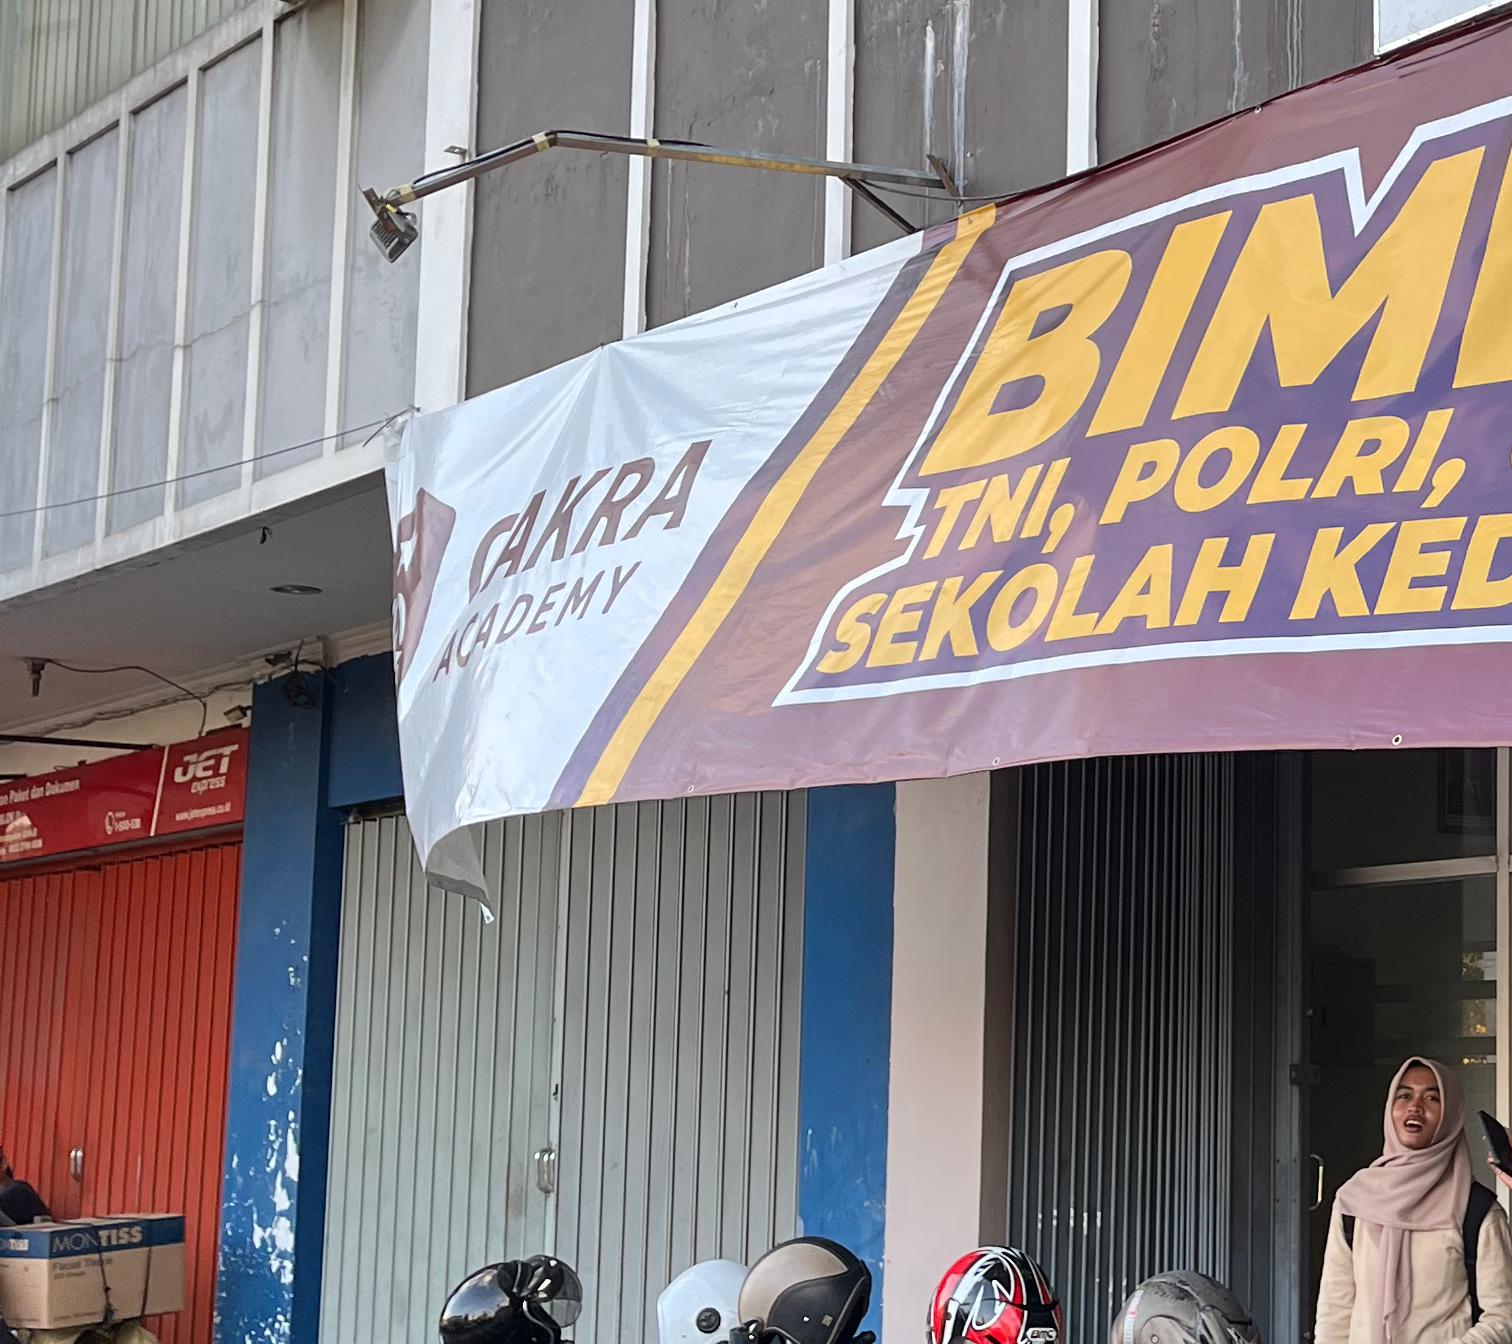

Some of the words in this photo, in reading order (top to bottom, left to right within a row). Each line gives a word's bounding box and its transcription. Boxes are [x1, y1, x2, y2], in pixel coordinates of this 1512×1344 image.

[468, 439, 713, 605] CAKRA
[921, 456, 1075, 557] TNI,
[1099, 409, 1467, 527] POLRI,
[432, 561, 642, 684] ACADEMY
[816, 532, 1272, 675] SEKOLAH
[173, 743, 240, 784] JET
